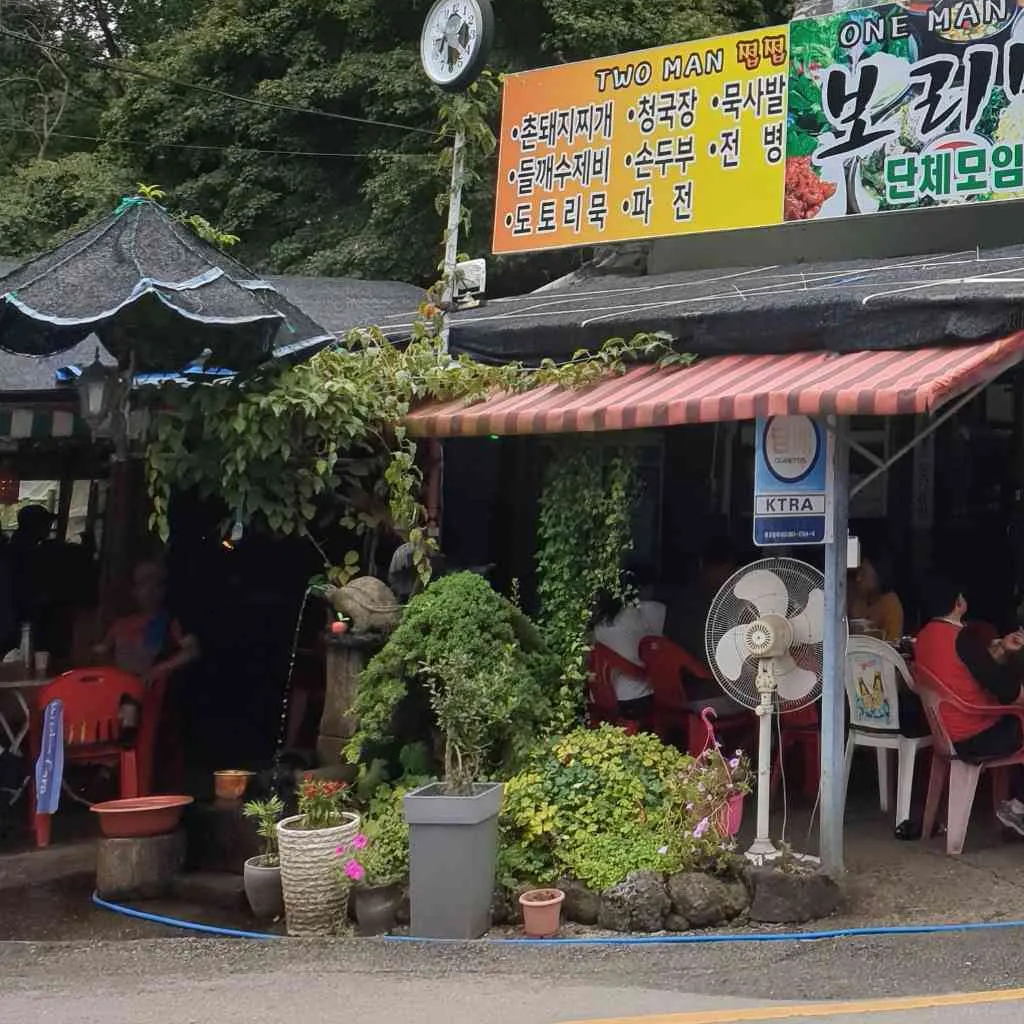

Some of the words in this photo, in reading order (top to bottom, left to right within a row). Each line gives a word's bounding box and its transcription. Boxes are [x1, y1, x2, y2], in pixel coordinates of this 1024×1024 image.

[839, 11, 910, 48] ONE
[596, 63, 652, 91] TWO
[663, 49, 724, 81] MAN
[520, 101, 614, 151] 촌돼지찌개
[638, 88, 698, 133] 청국장
[722, 74, 787, 120] 묵사발
[517, 147, 611, 196] 들깨수제비
[634, 136, 696, 179] 손두부
[885, 143, 1024, 200] 단체모임
[513, 193, 609, 236] 도토리묵
[766, 497, 814, 512] KTRA
